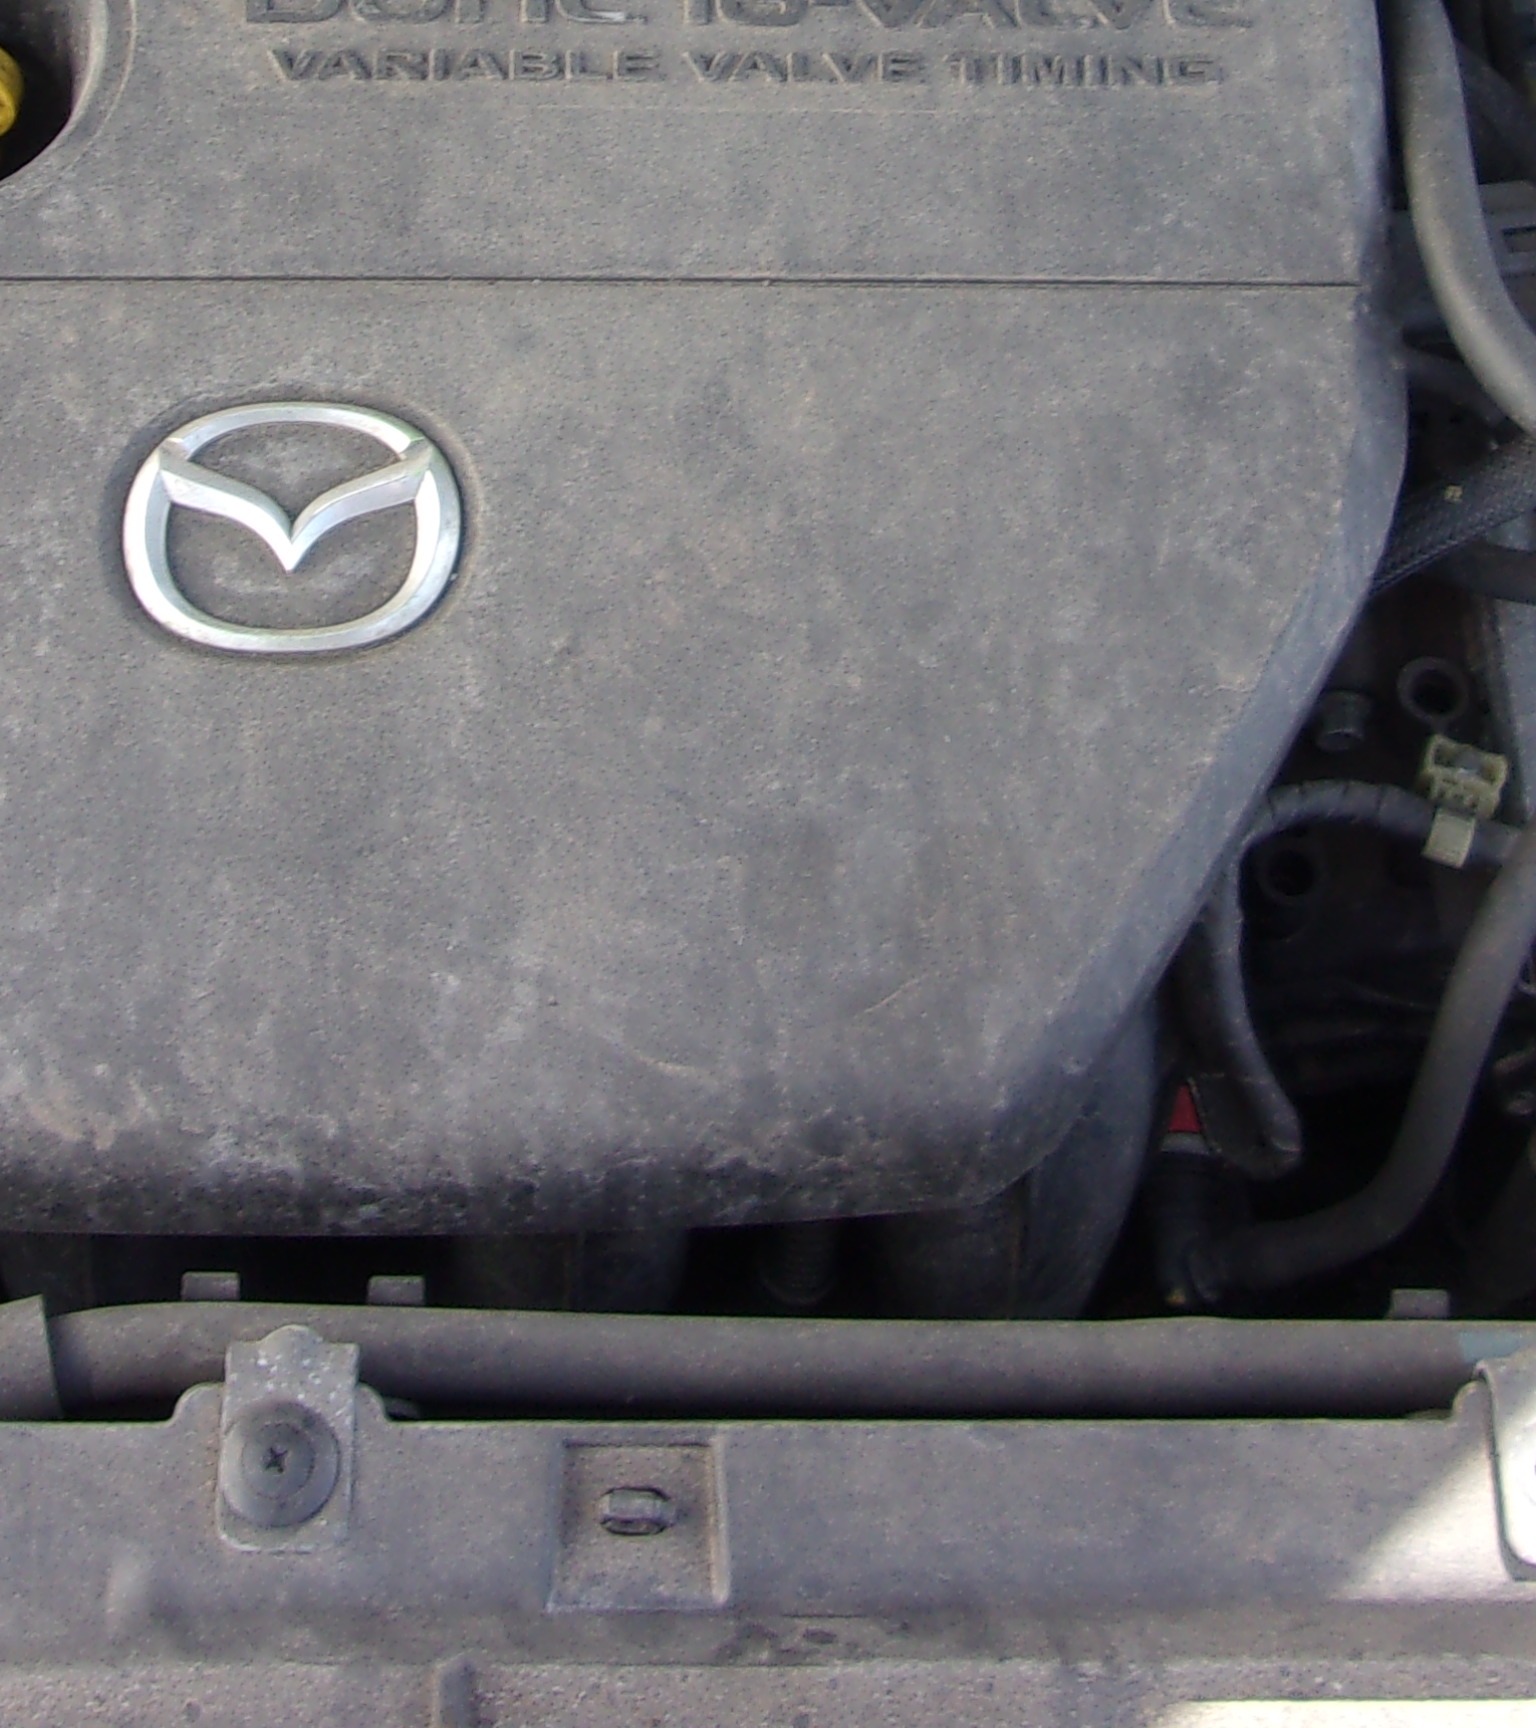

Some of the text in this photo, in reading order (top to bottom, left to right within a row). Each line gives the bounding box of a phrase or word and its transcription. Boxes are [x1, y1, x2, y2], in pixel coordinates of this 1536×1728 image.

[267, 46, 1221, 87] VARIABLE VALVE TIMING
